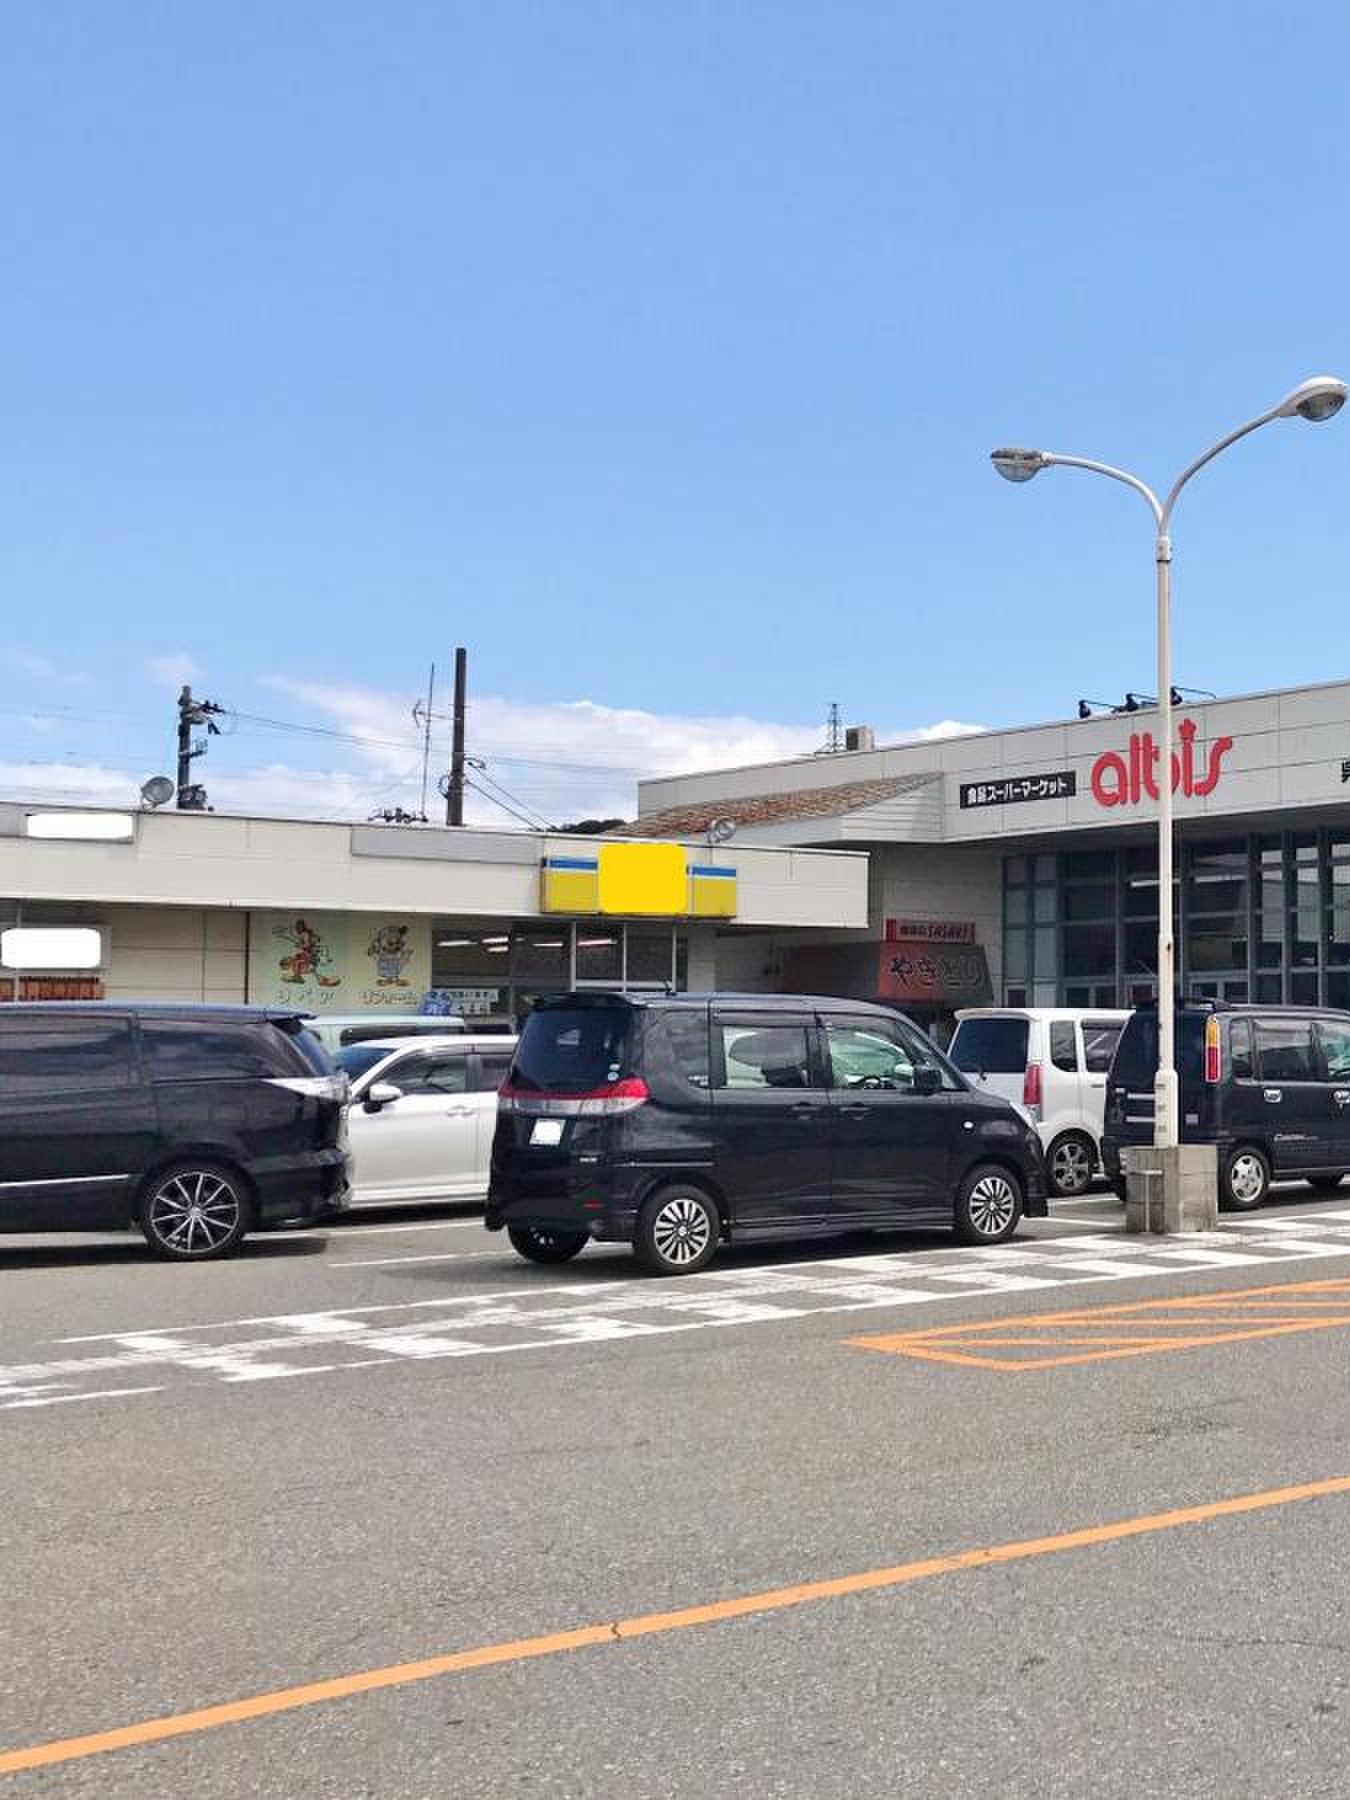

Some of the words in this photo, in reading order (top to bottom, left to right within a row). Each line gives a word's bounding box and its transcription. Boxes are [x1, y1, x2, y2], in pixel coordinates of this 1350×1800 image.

[967, 776, 1067, 804] 食品スーパーマーケット
[1091, 719, 1232, 807] albis
